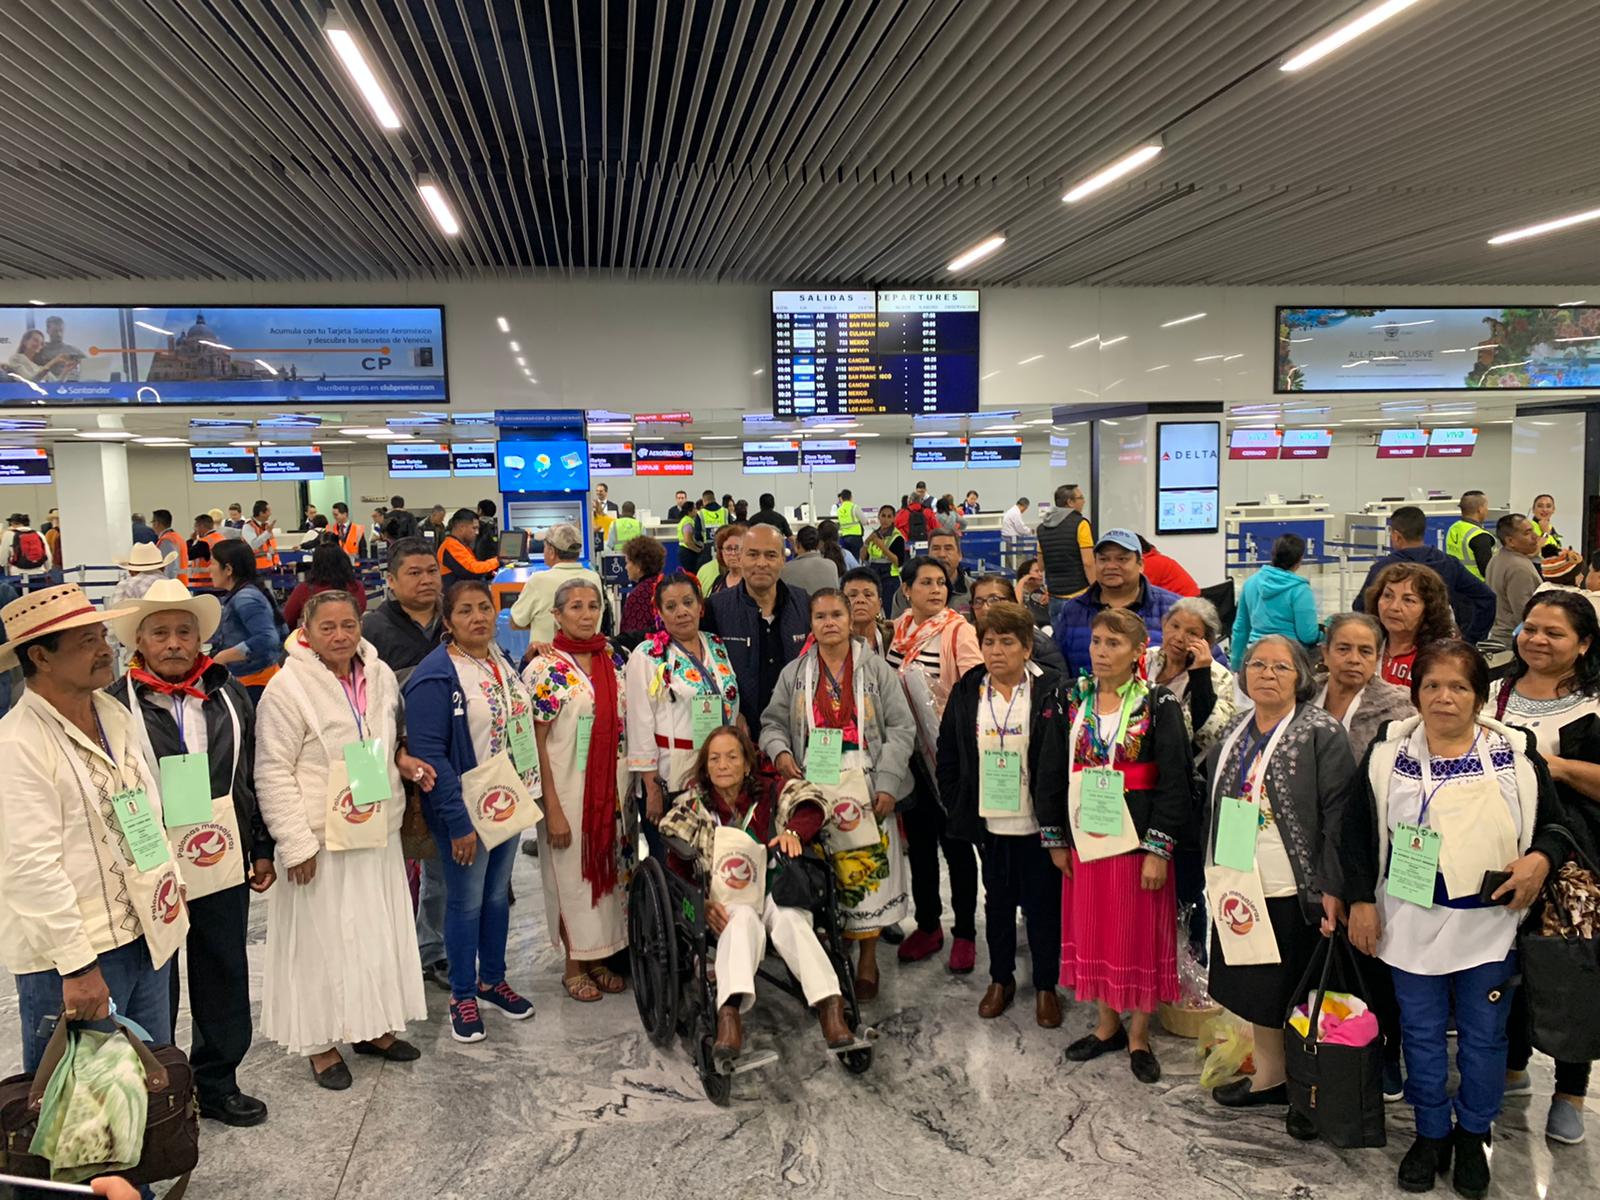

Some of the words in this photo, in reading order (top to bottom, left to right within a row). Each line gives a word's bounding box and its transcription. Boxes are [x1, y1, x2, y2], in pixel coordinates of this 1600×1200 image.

[327, 328, 351, 336] Tarjeta
[361, 357, 392, 370] CP
[1175, 450, 1217, 459] DELTA
[332, 786, 351, 811] Paloma
[177, 827, 200, 858] Palomas
[201, 823, 234, 850] mensajeras
[150, 879, 163, 921] Palomas
